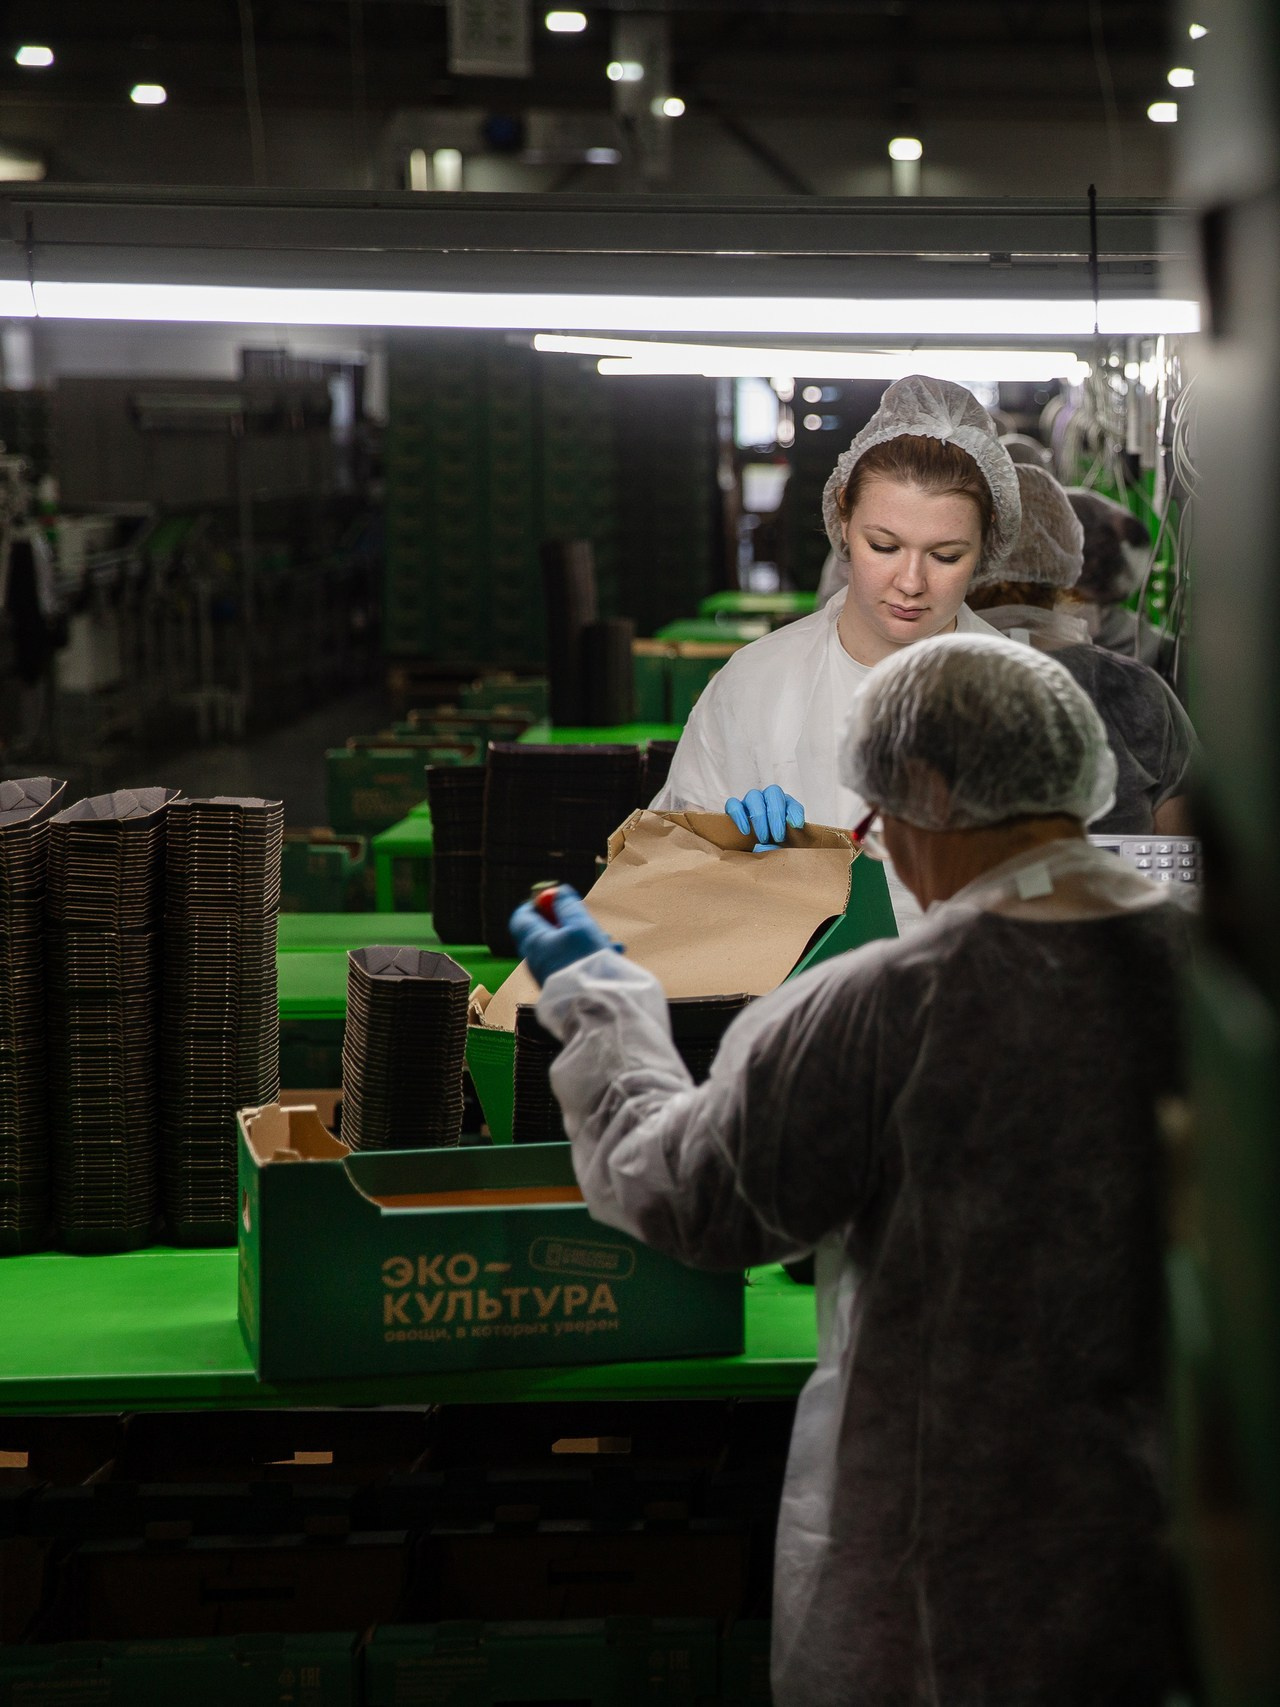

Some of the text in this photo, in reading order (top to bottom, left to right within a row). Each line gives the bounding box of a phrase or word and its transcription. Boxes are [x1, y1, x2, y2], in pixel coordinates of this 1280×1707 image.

[381, 1252, 512, 1288] ЭКО-
[383, 1283, 619, 1326] КУЛЬТУРА
[384, 1319, 620, 1342] овощи, в которых уверен
